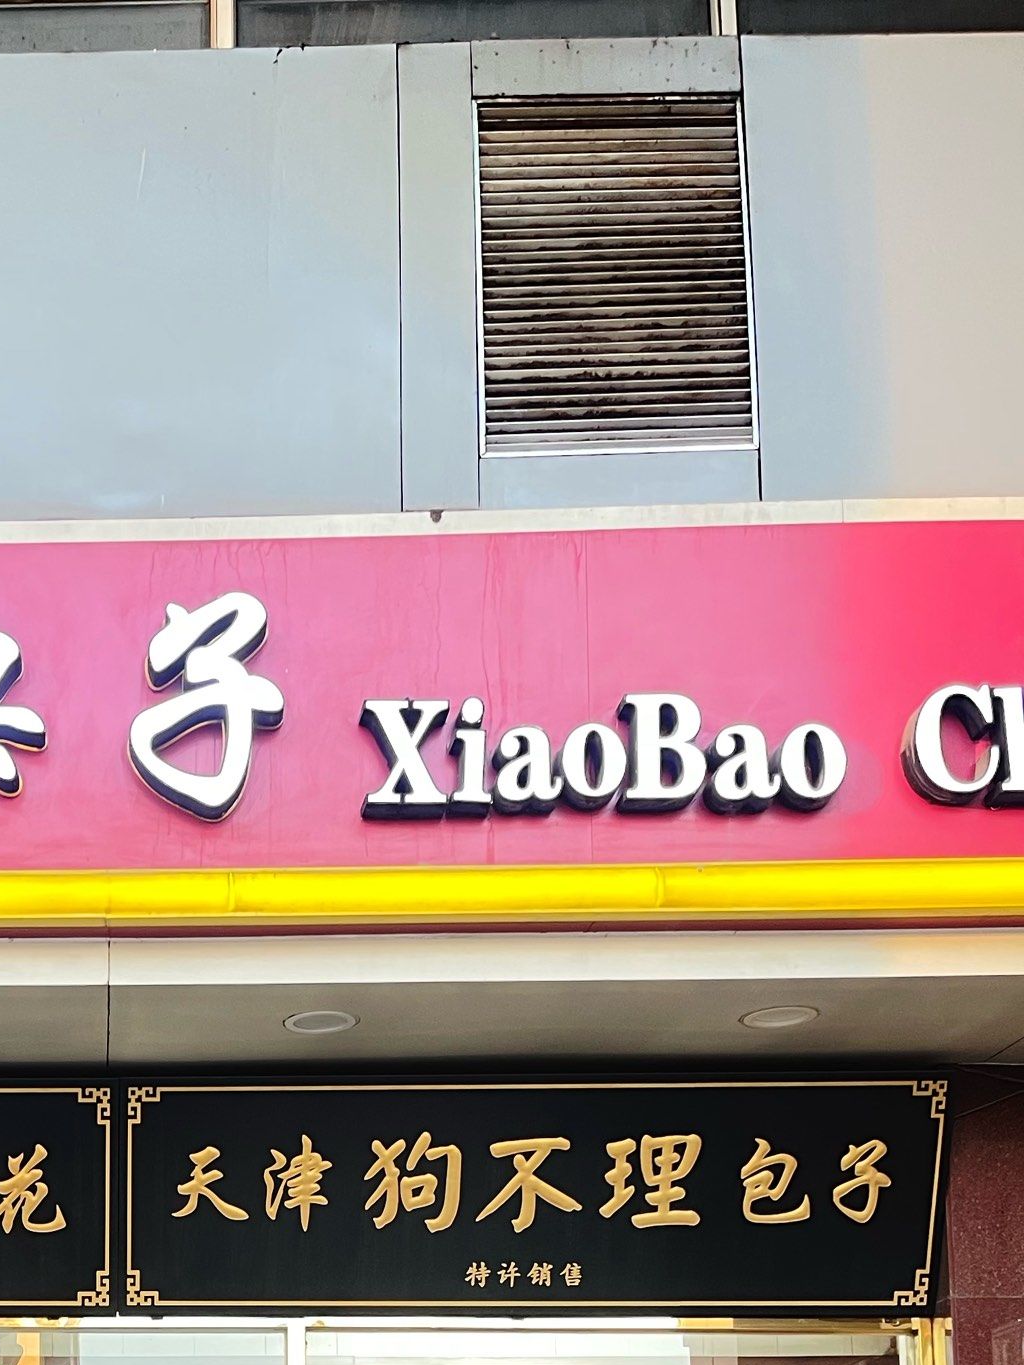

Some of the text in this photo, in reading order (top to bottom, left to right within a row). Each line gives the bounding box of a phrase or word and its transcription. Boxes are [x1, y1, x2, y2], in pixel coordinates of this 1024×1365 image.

[360, 693, 848, 820] XiaoBao
[464, 1261, 584, 1288] 特许销售
